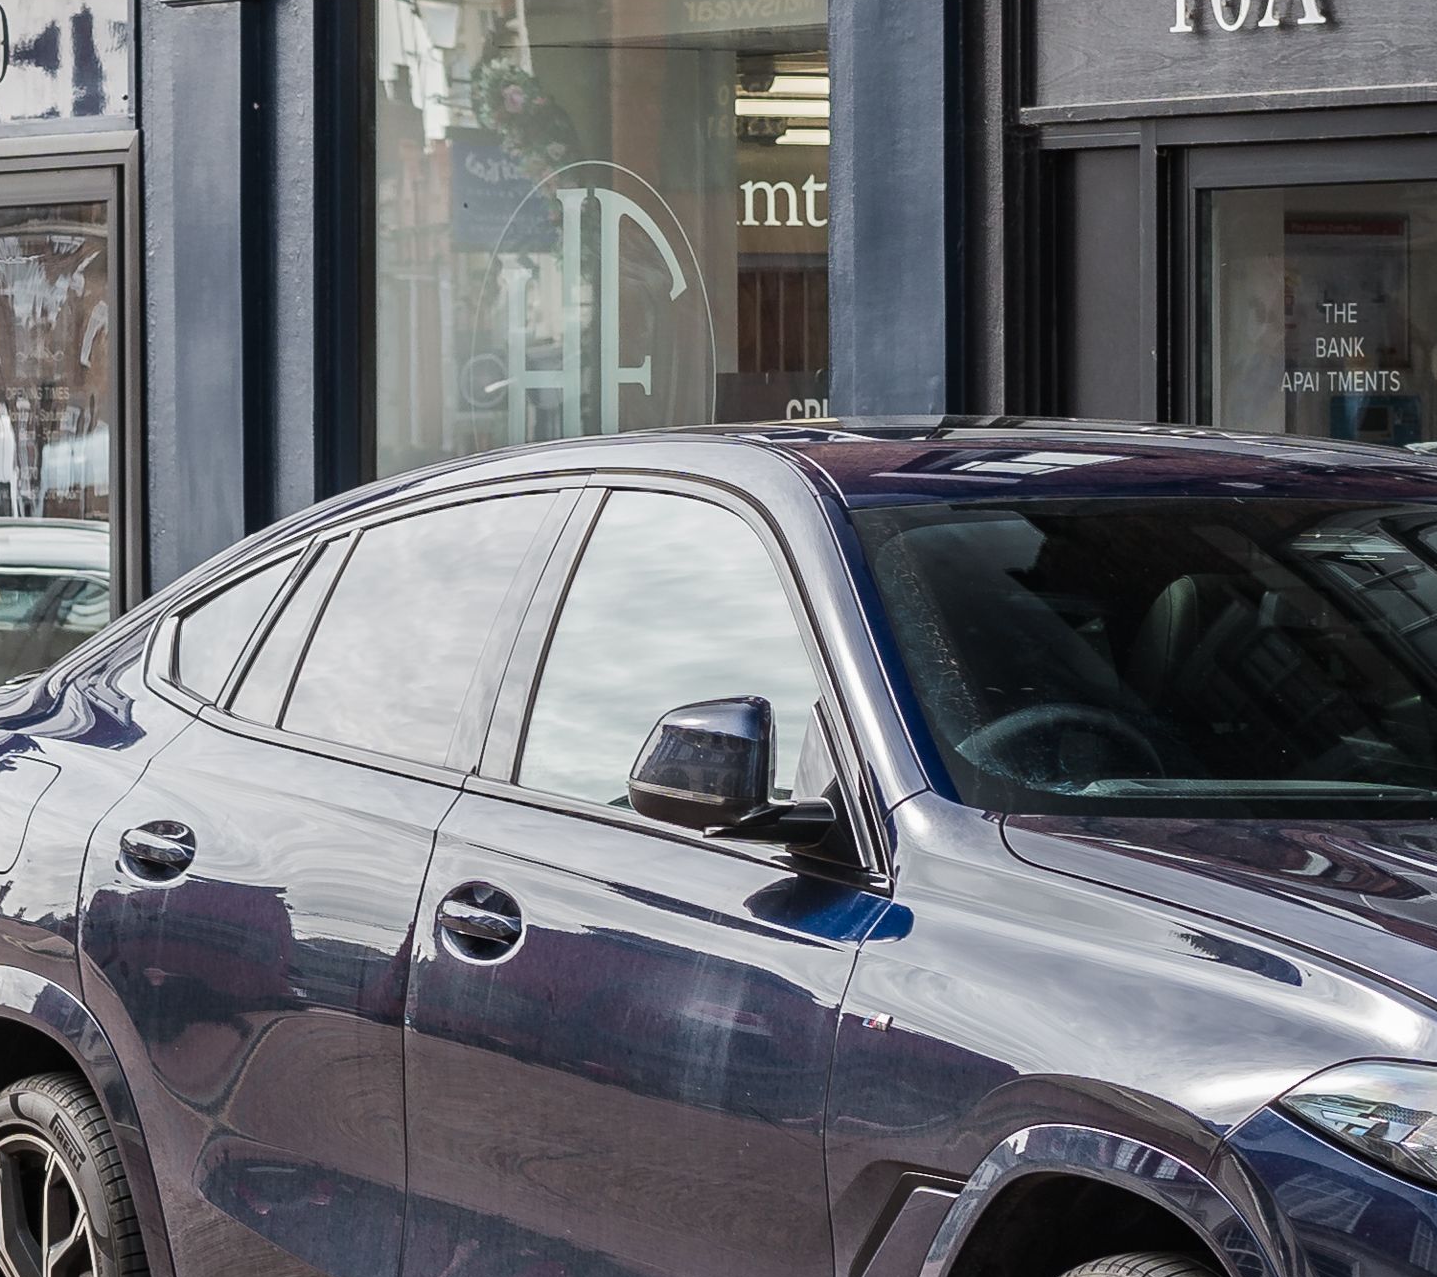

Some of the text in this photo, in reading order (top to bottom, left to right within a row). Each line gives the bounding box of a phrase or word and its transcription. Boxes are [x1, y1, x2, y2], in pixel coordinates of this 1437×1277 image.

[1323, 302, 1358, 323] THE
[1315, 337, 1365, 358] BANK
[48, 1112, 86, 1173] PIRELLI
